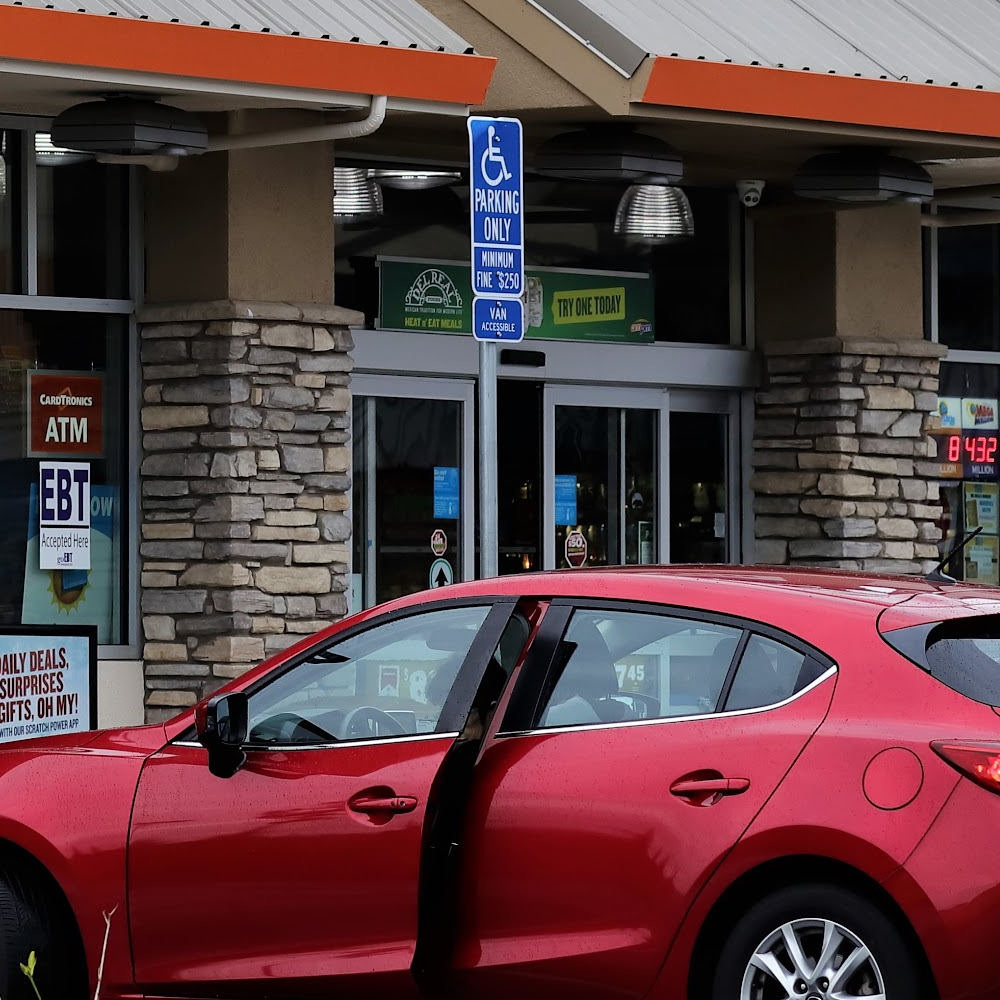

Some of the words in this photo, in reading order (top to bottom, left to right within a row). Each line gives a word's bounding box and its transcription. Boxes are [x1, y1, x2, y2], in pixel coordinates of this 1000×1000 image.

[475, 188, 519, 215] PARKING
[484, 216, 511, 242] ONLY
[482, 250, 513, 269] MINIMUM
[413, 274, 430, 301] DEL
[432, 271, 455, 303] REAL
[477, 271, 492, 288] FINE
[499, 271, 519, 290] $250
[490, 307, 506, 320] VAN
[558, 297, 574, 318] TRY
[576, 297, 592, 316] ONE
[594, 295, 620, 315] TODAY
[405, 317, 420, 327] HEAT
[429, 318, 439, 328] EAT
[441, 319, 462, 329] MEALS
[482, 322, 515, 332] ACCESSIBLE
[45, 416, 87, 443] ATM
[965, 437, 997, 462] 432
[972, 465, 994, 474] MILLION
[41, 468, 88, 521] EBT
[42, 533, 71, 550] Accepted
[74, 534, 88, 548] Here
[30, 647, 68, 672] DEALS,
[0, 671, 63, 699] SURPRISES
[38, 697, 53, 719] OH
[57, 693, 78, 716] MY!
[0, 728, 12, 738] WITH
[14, 726, 24, 736] OUR
[26, 723, 49, 734] SCRATCH
[50, 721, 68, 732] POWER
[69, 719, 79, 729] APP
